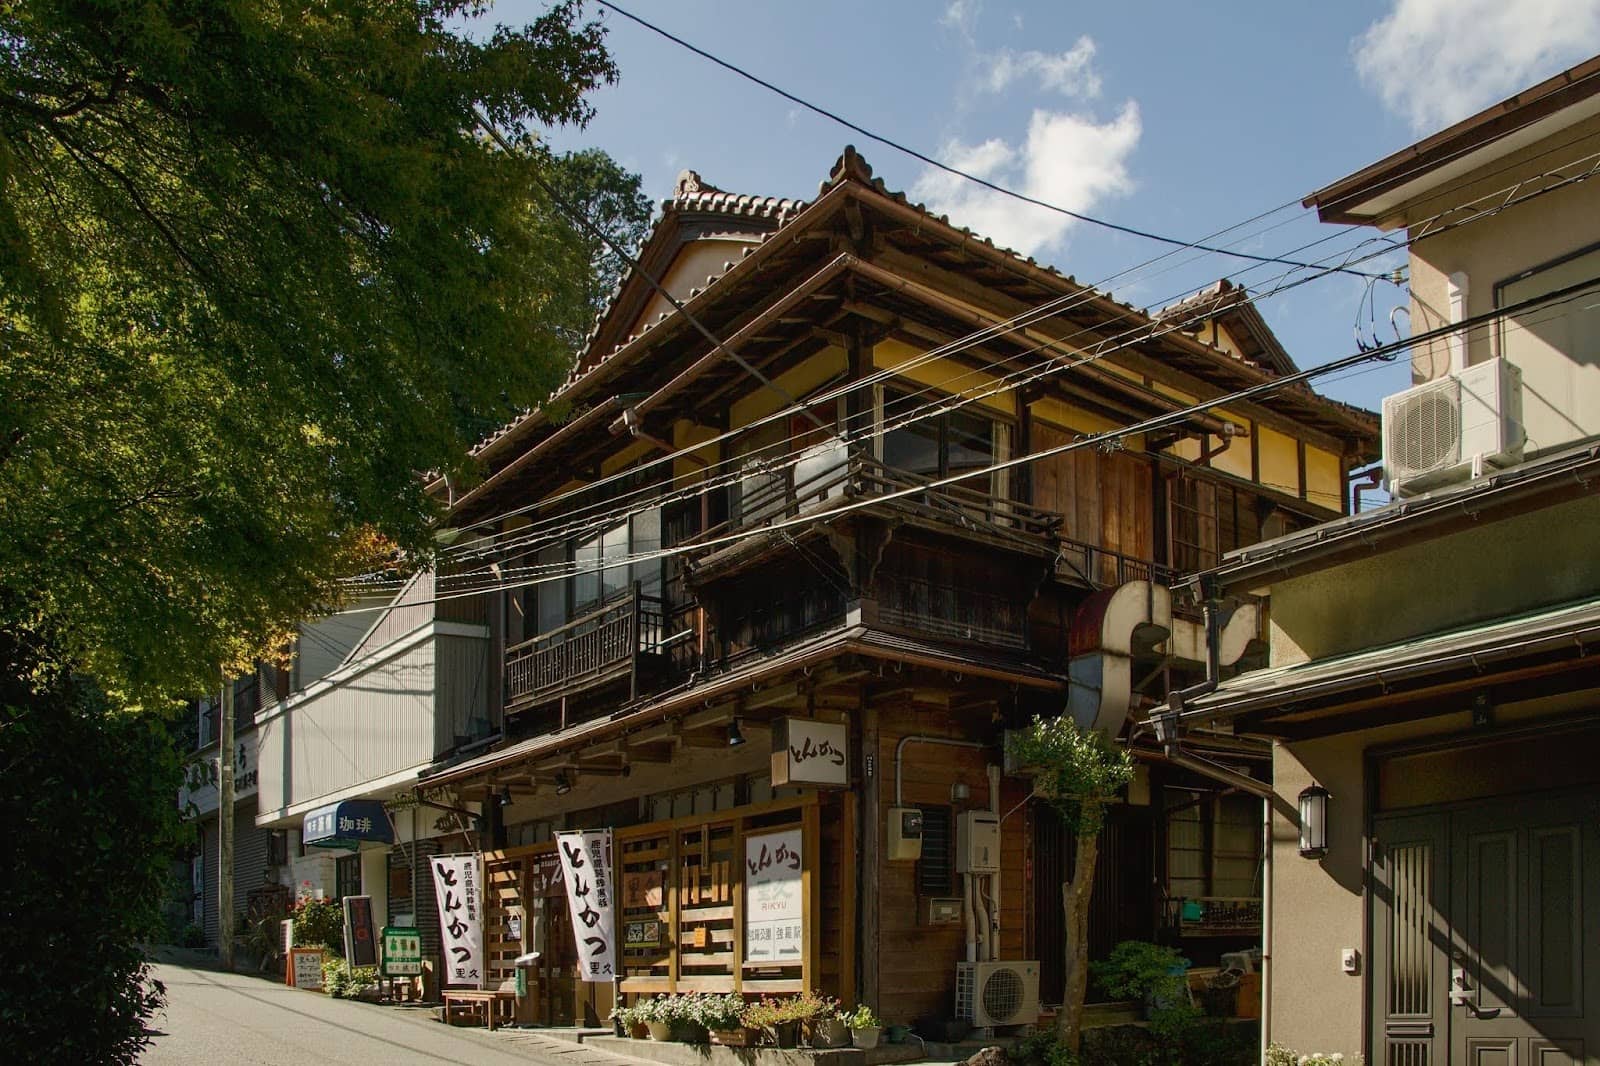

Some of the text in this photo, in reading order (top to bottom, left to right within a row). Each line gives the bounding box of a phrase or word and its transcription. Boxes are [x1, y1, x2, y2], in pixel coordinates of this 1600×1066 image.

[790, 736, 845, 767] とんかつ
[339, 815, 373, 833] 珈琲
[747, 841, 801, 876] とんかつ
[436, 862, 472, 964] とんかつ
[562, 841, 607, 957] とんかつ
